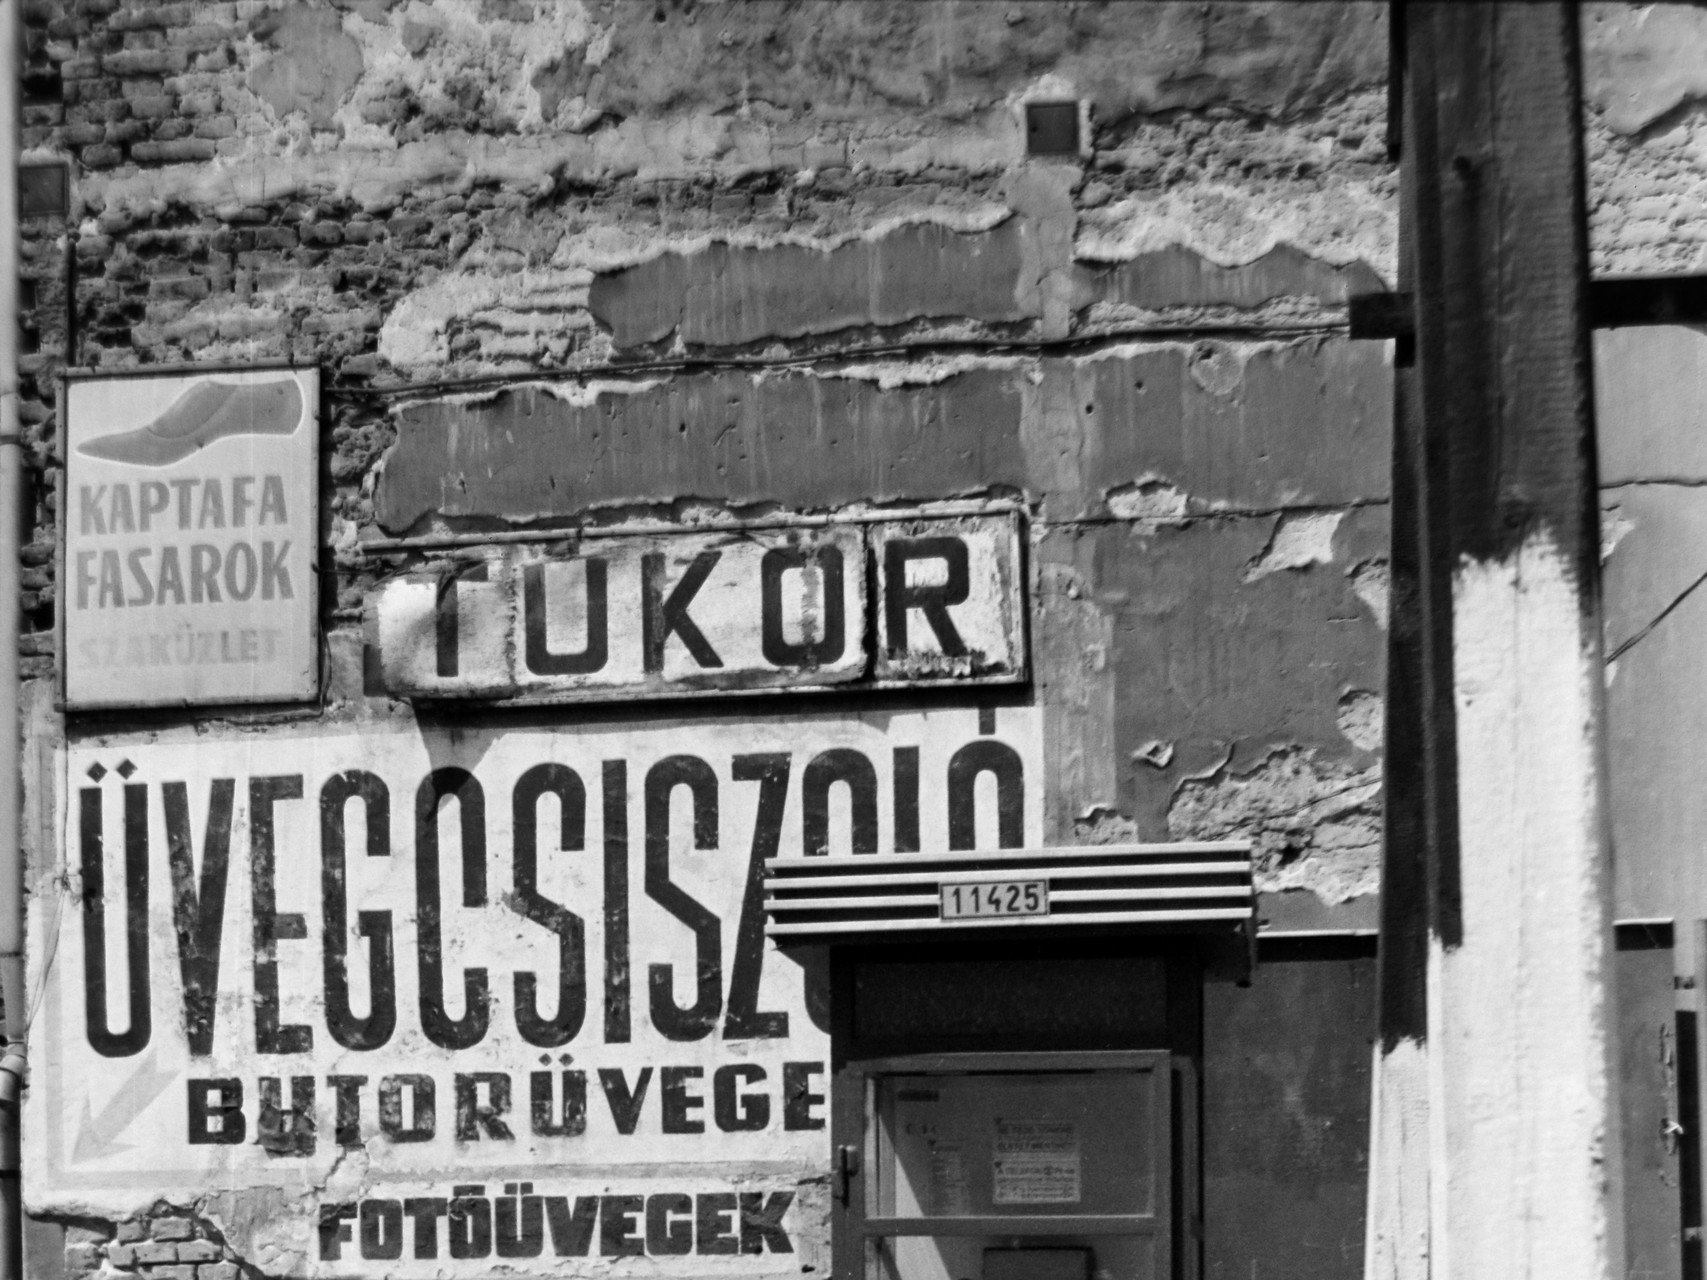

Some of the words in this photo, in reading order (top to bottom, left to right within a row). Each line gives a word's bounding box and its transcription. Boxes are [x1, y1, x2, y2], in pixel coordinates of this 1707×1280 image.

[80, 474, 288, 536] KAPTAFA
[76, 540, 295, 611] FASAROK
[78, 622, 282, 668] SZAKÜZLET
[952, 883, 1039, 914] 11425
